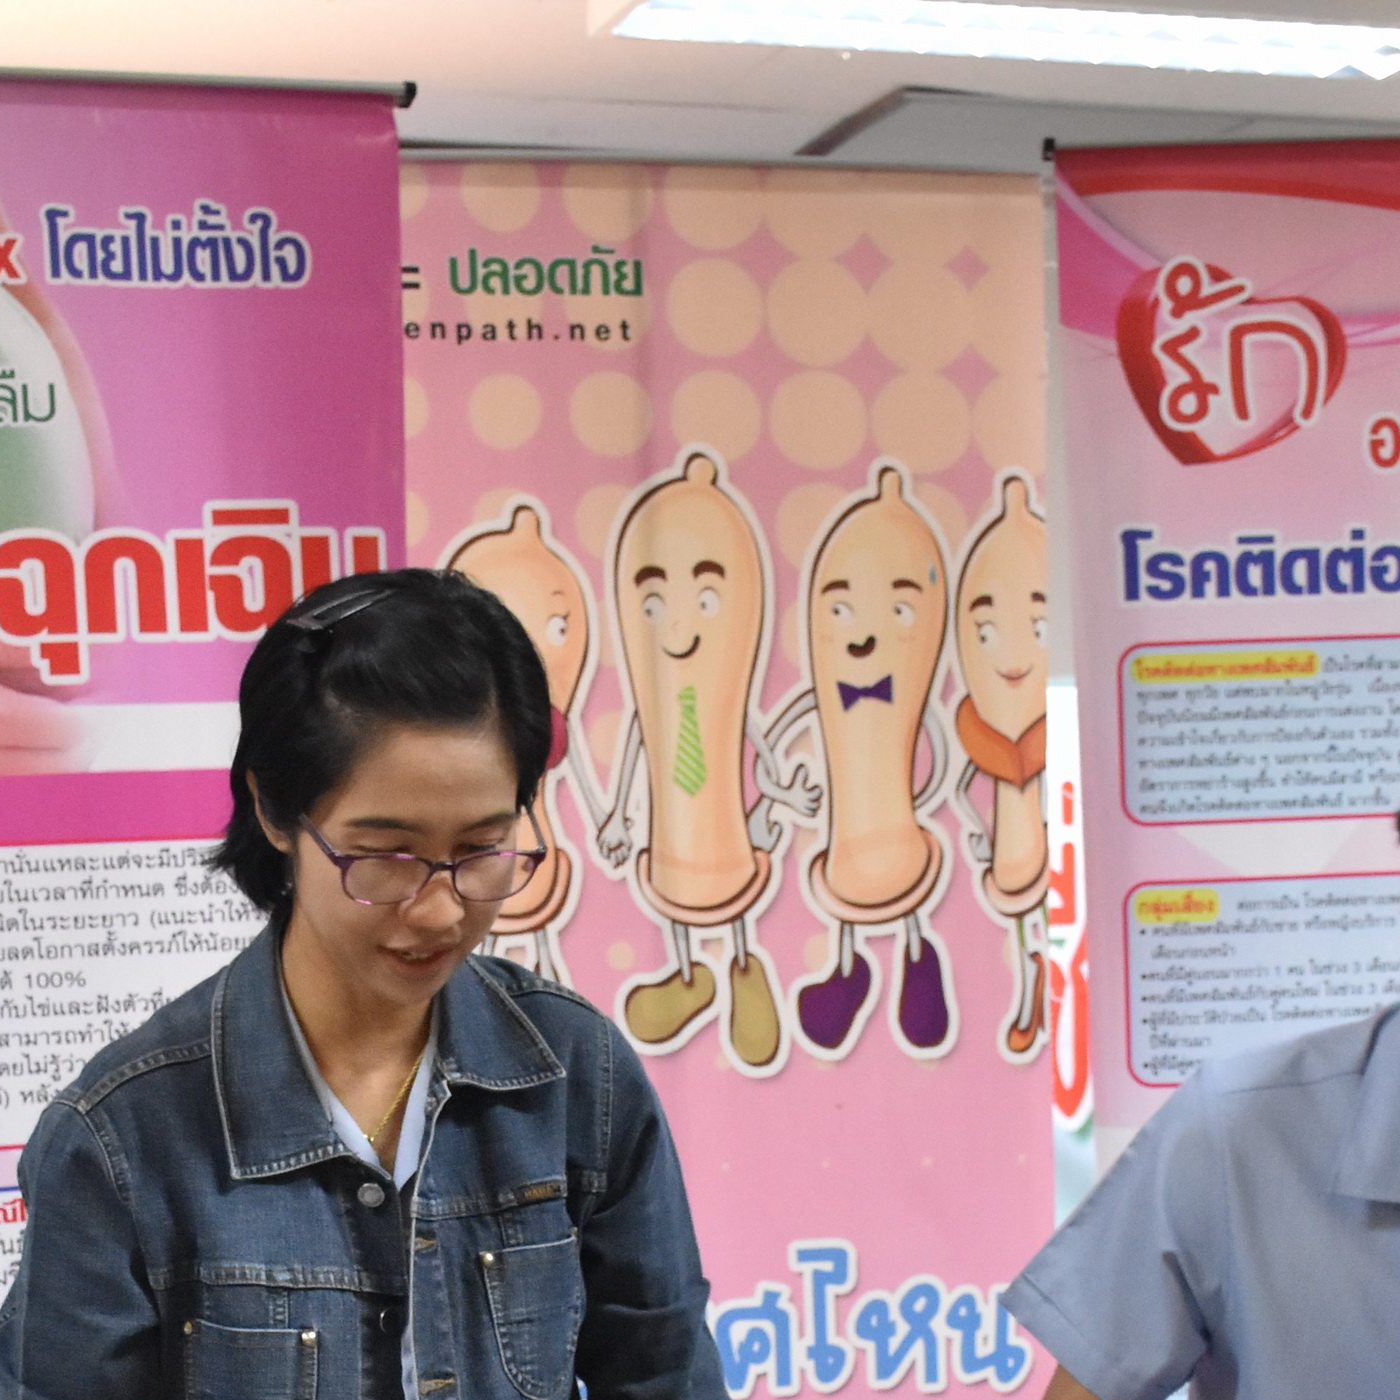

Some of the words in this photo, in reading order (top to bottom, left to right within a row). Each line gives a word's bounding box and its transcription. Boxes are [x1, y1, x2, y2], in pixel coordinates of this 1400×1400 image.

[46, 202, 308, 286] โดยไม่ตั้งใจ
[449, 244, 643, 297] ปลอดภัย
[1153, 261, 1320, 426] รัก
[24, 970, 87, 990] 100%
